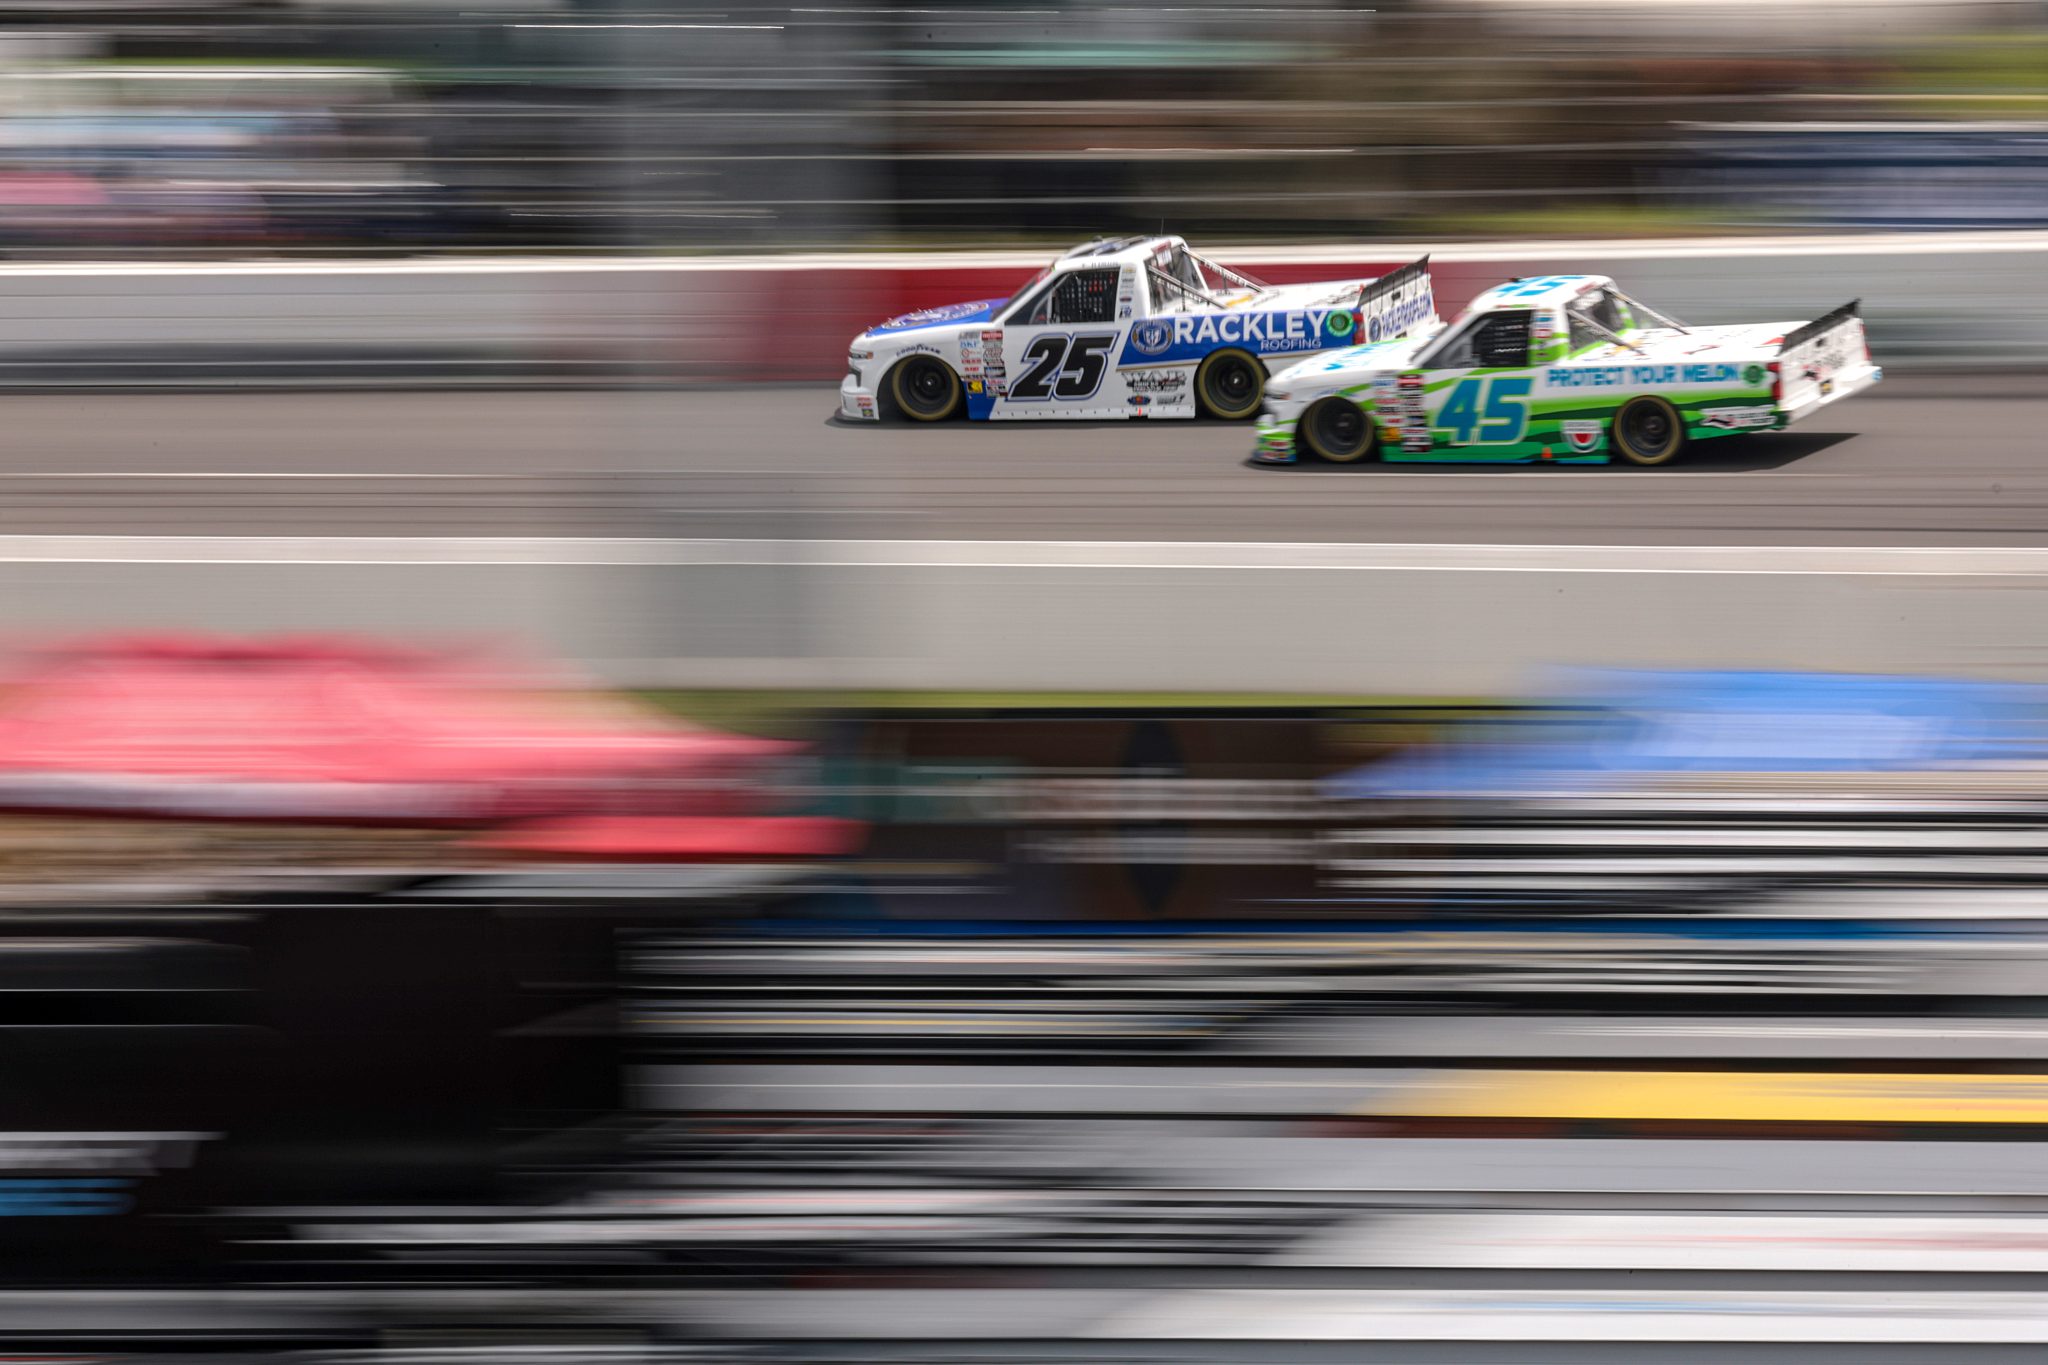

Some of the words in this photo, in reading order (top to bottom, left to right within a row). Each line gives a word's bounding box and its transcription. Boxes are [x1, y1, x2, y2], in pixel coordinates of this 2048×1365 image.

[1174, 311, 1328, 345] RACKLEY
[1260, 337, 1322, 351] ROOFING
[1005, 331, 1121, 402] 25
[1546, 366, 1625, 387] PROTECT
[1631, 364, 1677, 385] YOUR
[1682, 363, 1740, 383] MELON
[1435, 376, 1537, 445] 45
